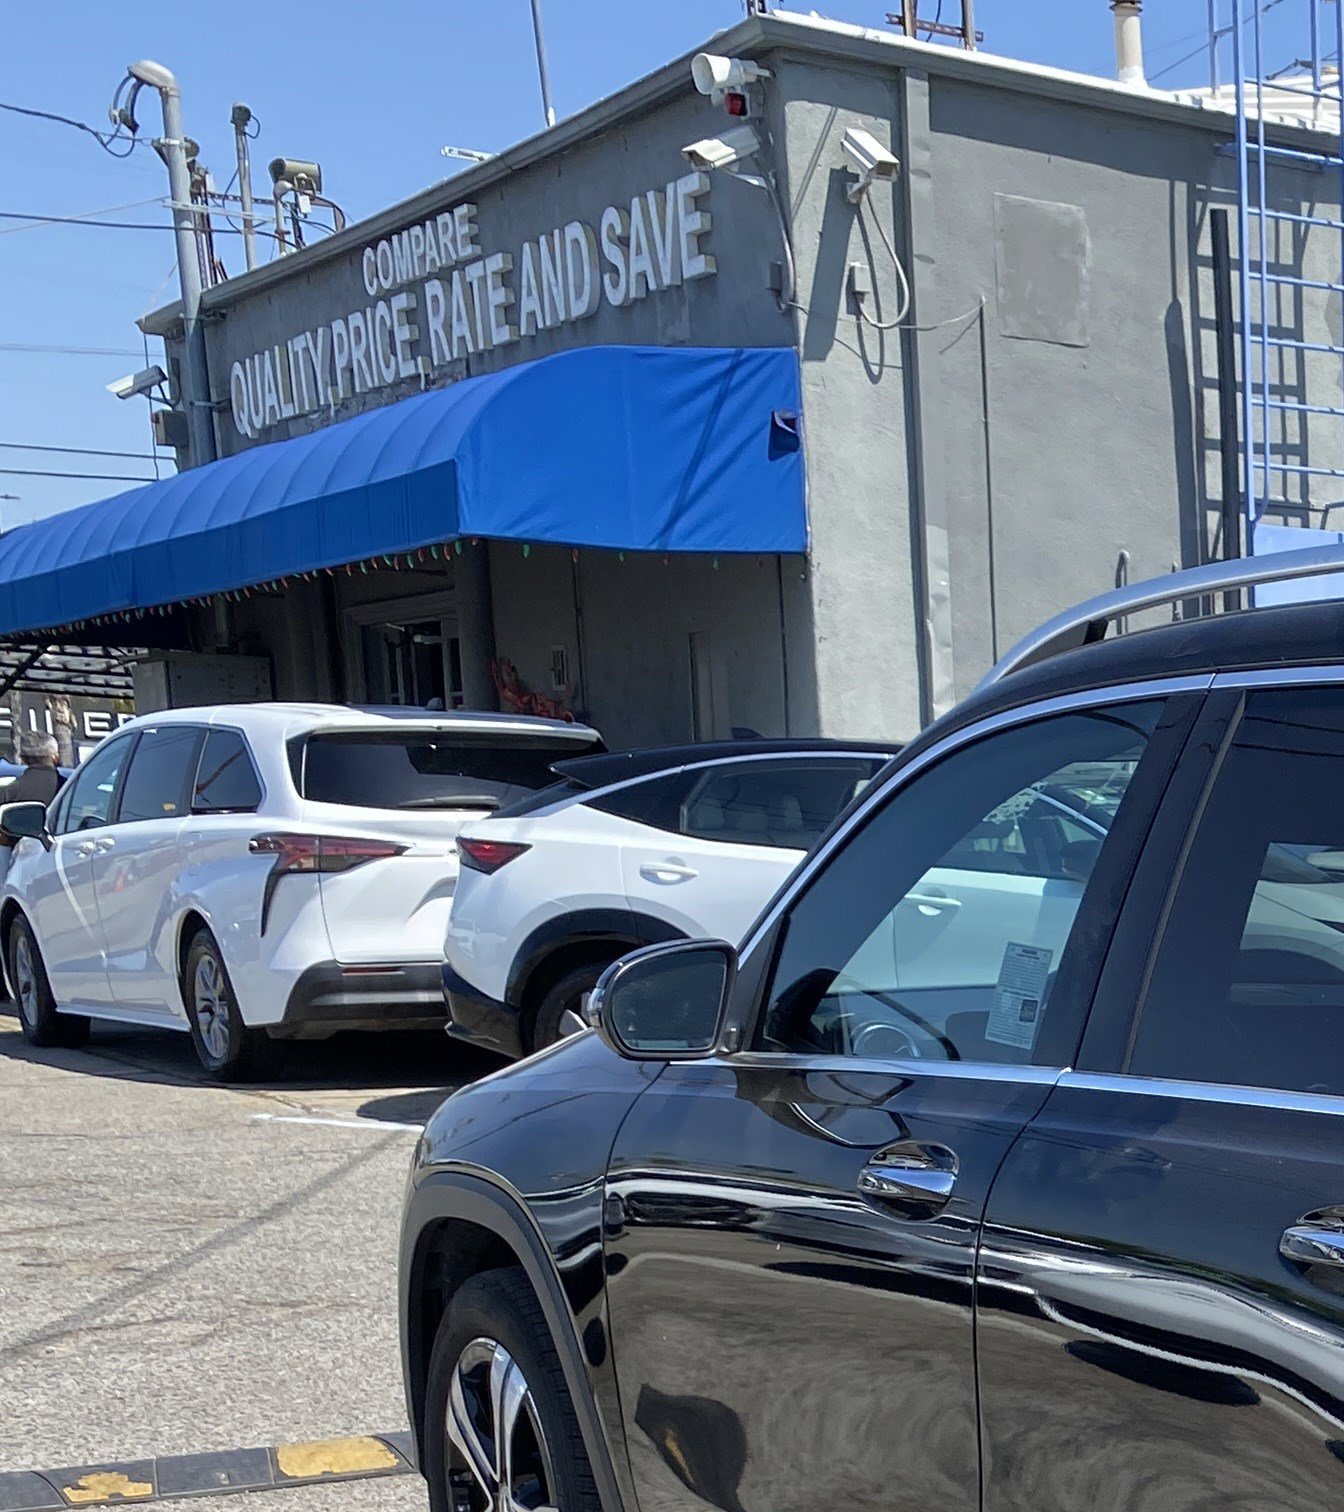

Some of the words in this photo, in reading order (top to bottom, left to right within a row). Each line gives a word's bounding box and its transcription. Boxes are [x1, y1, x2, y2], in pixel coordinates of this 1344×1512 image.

[331, 292, 430, 390] PRICE,
[424, 252, 519, 365] RATE
[520, 221, 600, 336] AND
[602, 172, 716, 307] SAVE
[363, 203, 481, 297] COMPARE
